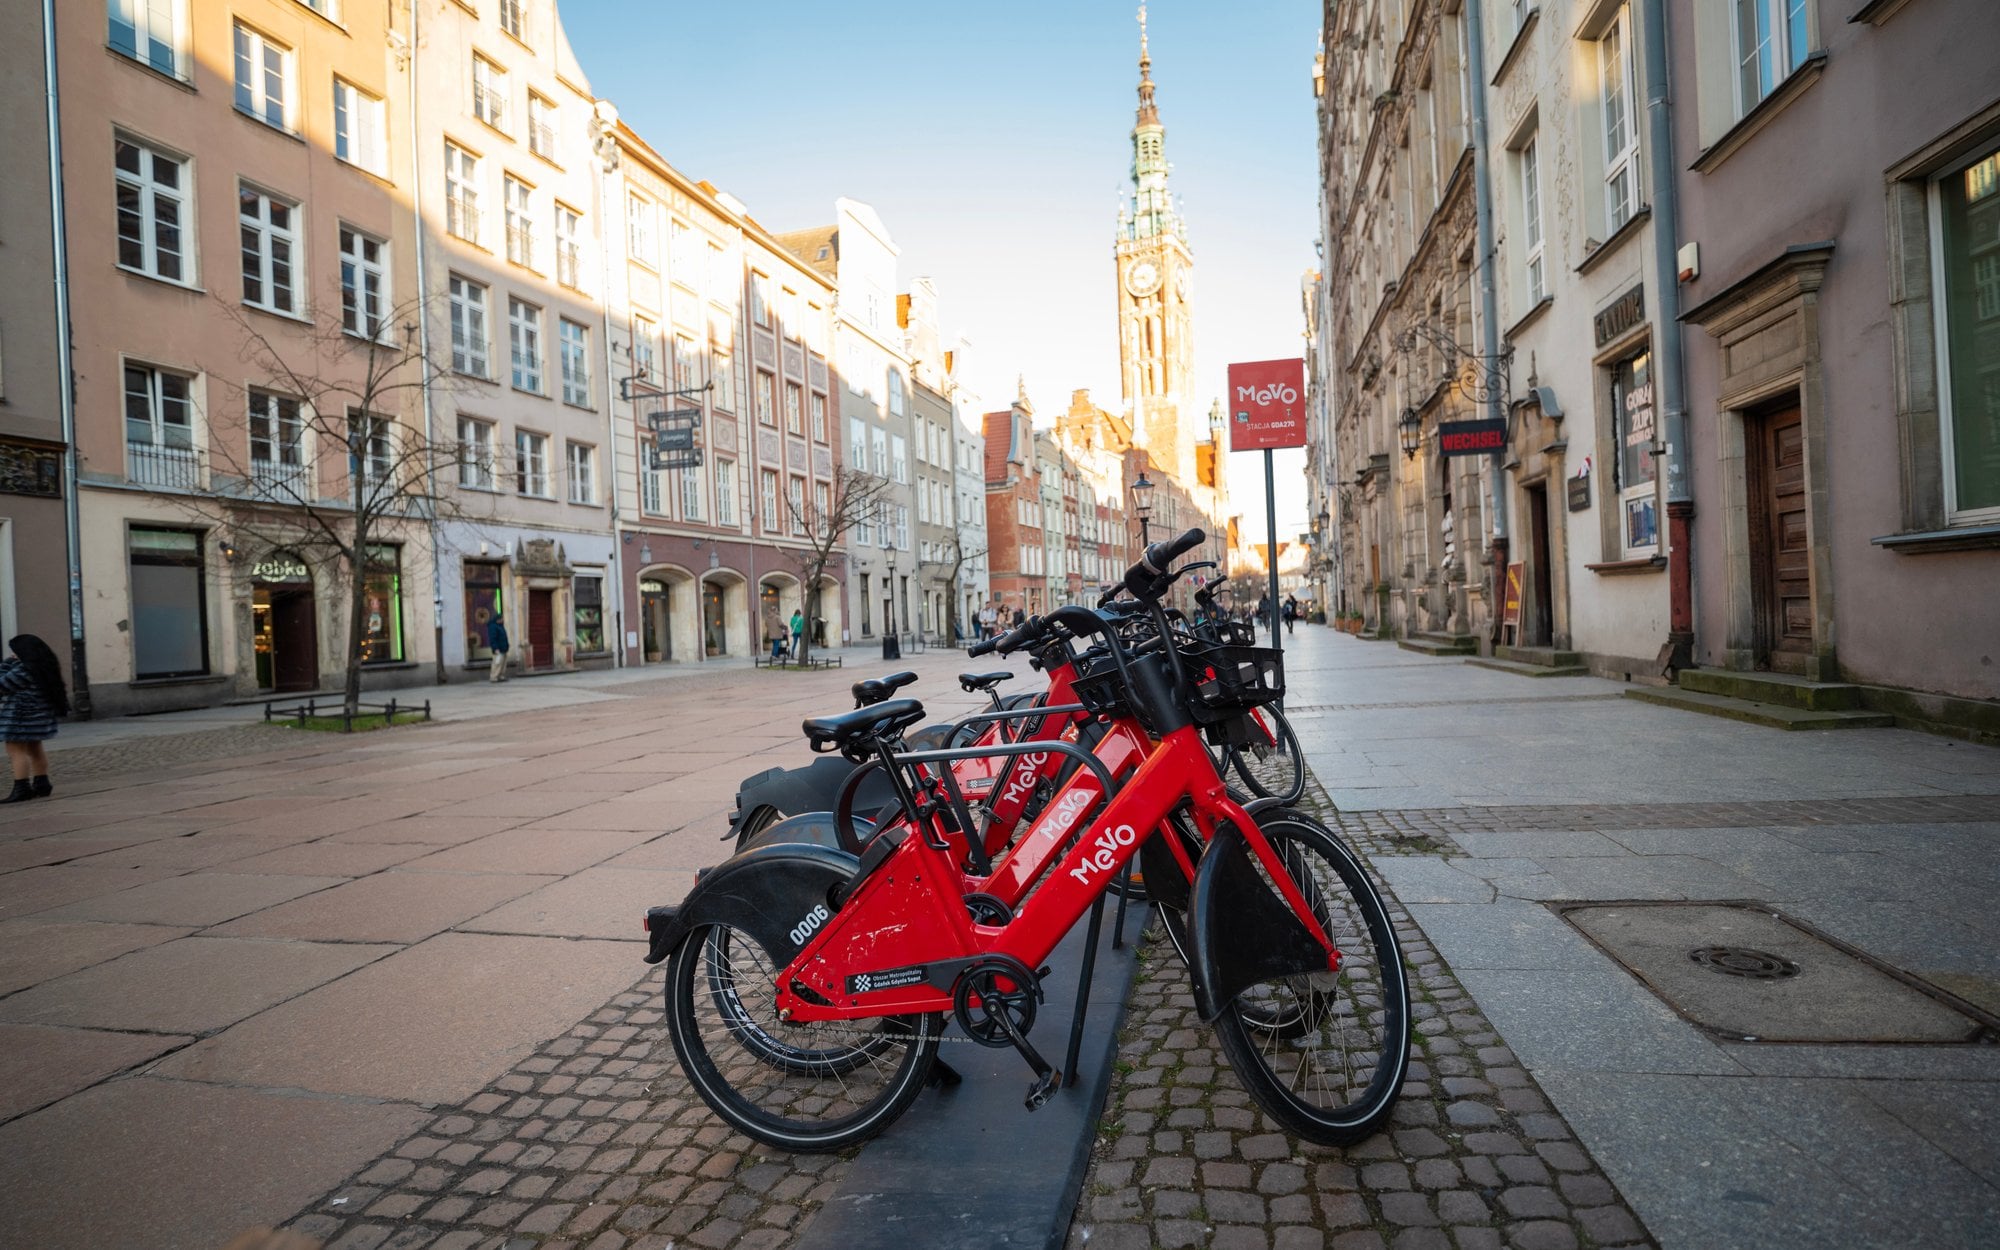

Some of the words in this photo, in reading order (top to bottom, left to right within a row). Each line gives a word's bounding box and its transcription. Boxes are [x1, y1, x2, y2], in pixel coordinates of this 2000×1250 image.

[1246, 422, 1270, 431] STACJA
[1271, 420, 1295, 429] GDA270
[1441, 430, 1504, 451] WECHSEL
[789, 904, 829, 946] 0006
